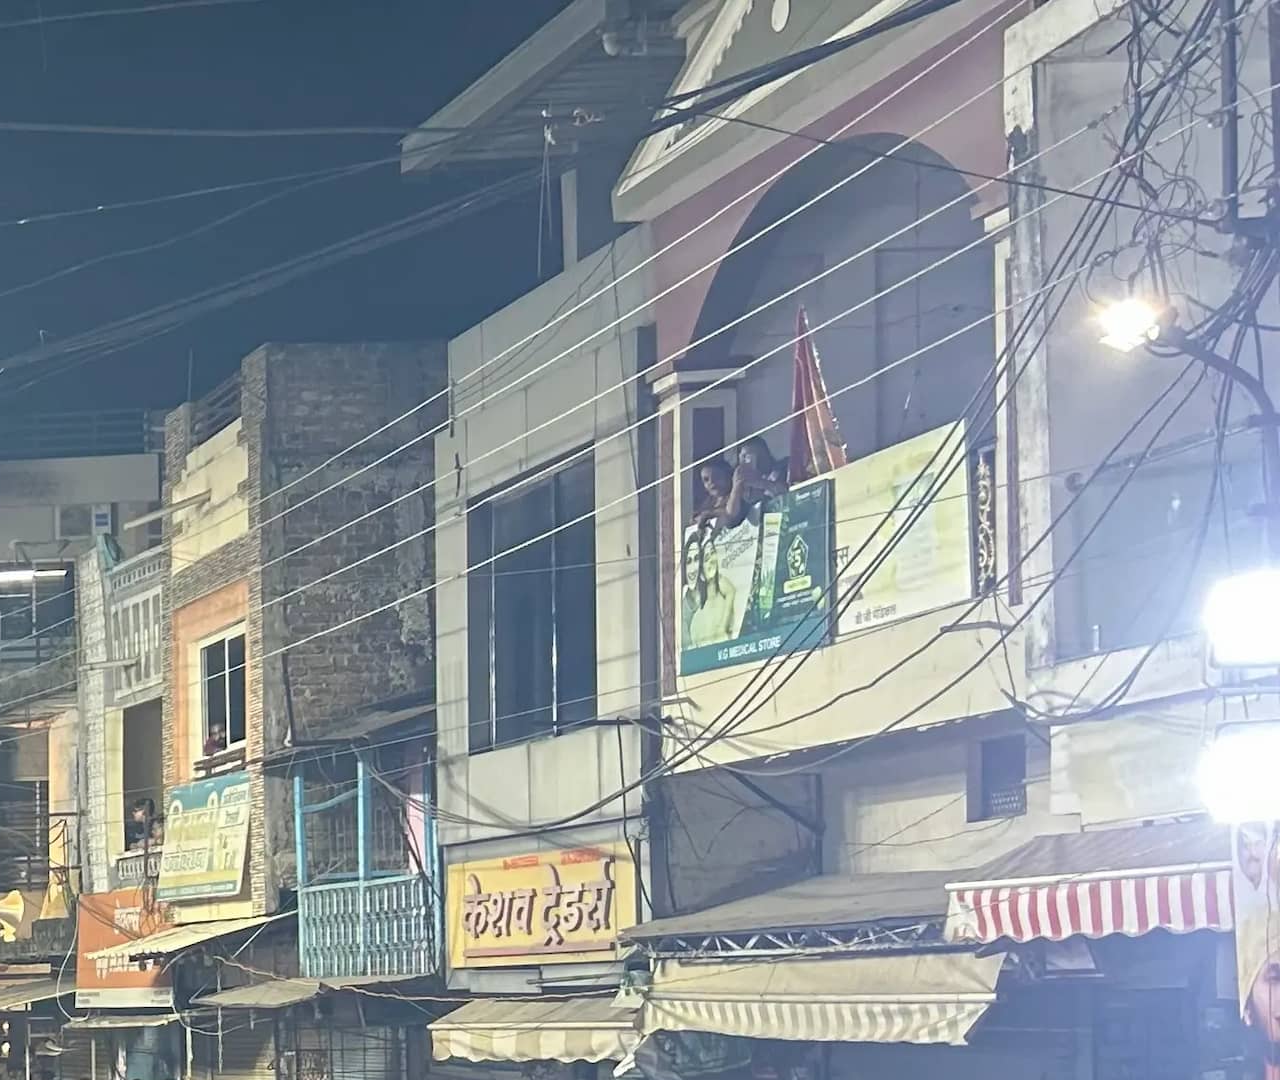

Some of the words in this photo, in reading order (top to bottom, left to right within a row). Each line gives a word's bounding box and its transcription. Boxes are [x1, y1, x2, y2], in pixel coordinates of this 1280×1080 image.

[729, 643, 757, 659] MEDICAL
[758, 635, 782, 652] STORE
[463, 873, 537, 940] केशव
[541, 855, 616, 946] ट्रेडर्स
